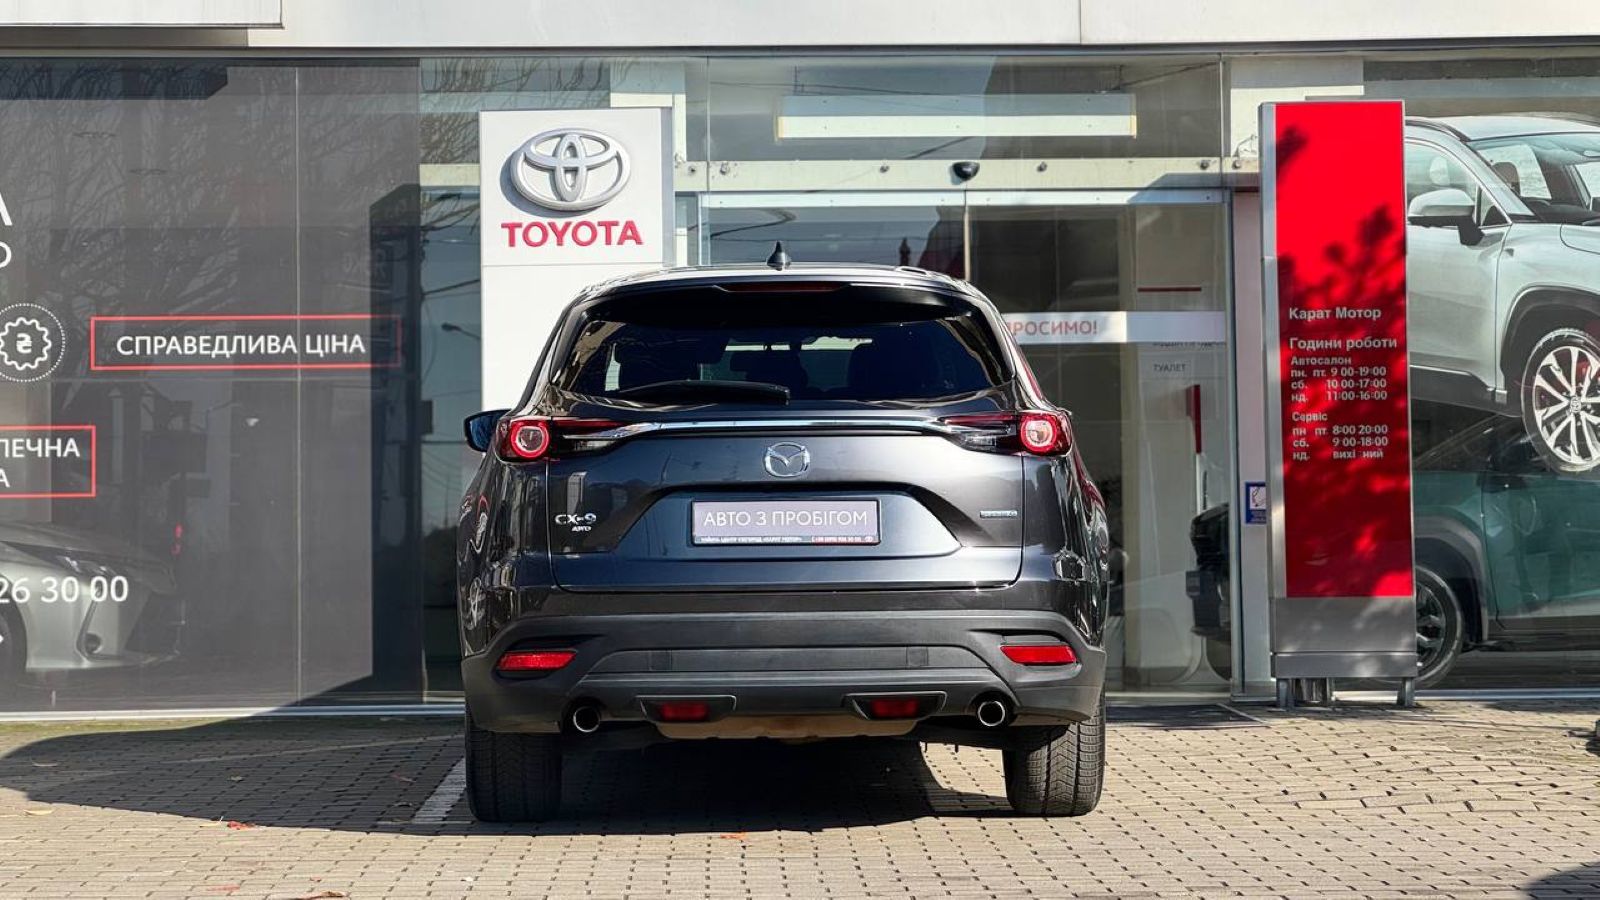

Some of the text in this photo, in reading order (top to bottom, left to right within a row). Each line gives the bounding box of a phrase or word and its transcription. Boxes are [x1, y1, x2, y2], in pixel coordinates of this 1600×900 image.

[501, 220, 643, 247] TOYOTA
[1289, 306, 1381, 321] Карат Мотор
[116, 334, 366, 358] СПРАВЕДЛИВА ЦІНА
[1289, 336, 1397, 352] Години роботи
[1153, 363, 1186, 373] ТУАЛЕТ
[1290, 356, 1352, 366] Автосалон
[1292, 412, 1328, 423] Сервіс
[555, 512, 597, 525] CX-9
[703, 511, 751, 527] АВТО
[772, 510, 868, 526] ПРОБІГОМ
[40, 576, 79, 603] 30
[90, 575, 129, 603] 00
